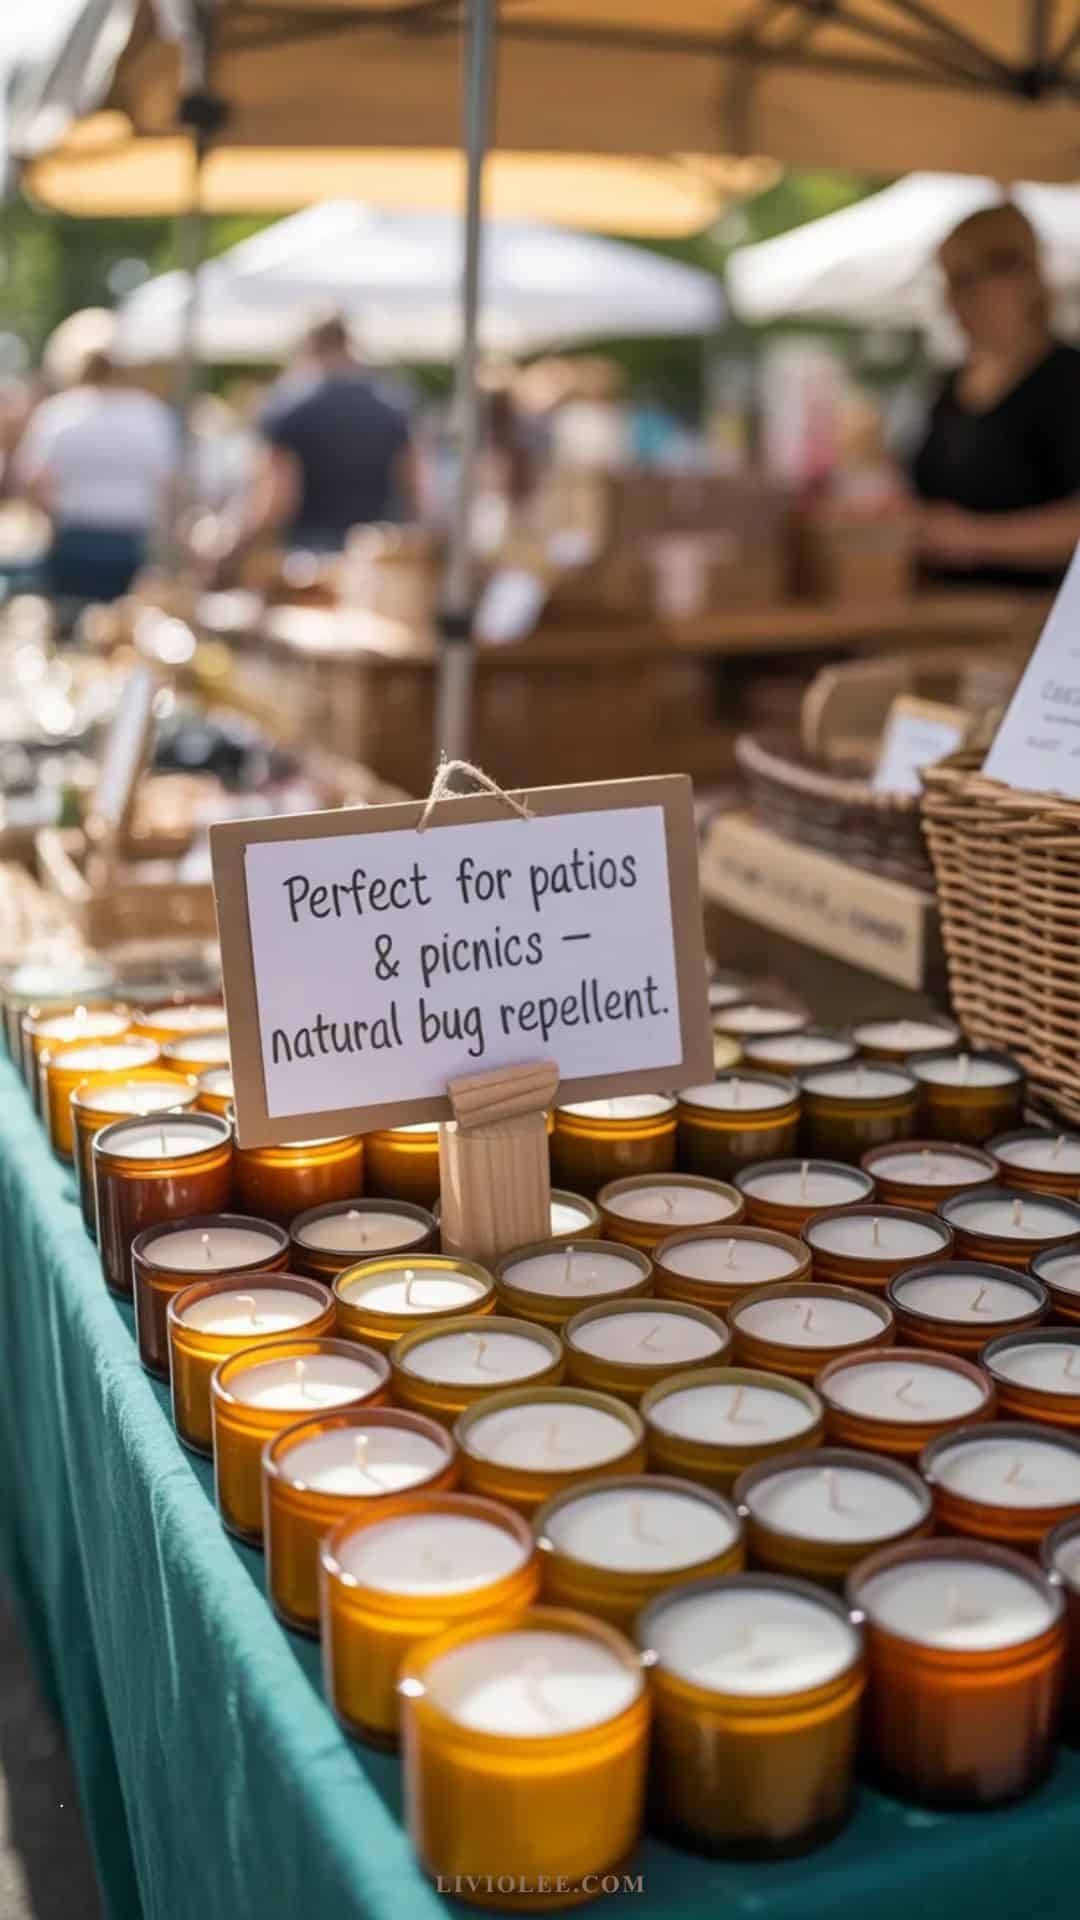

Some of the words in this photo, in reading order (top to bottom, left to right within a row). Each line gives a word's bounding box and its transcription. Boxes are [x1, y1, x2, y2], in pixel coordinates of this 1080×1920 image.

[283, 863, 432, 922] Perfect
[456, 857, 513, 905] for
[530, 847, 637, 912] patios
[375, 933, 400, 981] &
[420, 926, 543, 988] picnics
[272, 1001, 403, 1064] natural
[419, 997, 485, 1058] bug
[500, 976, 669, 1043] repellent.
